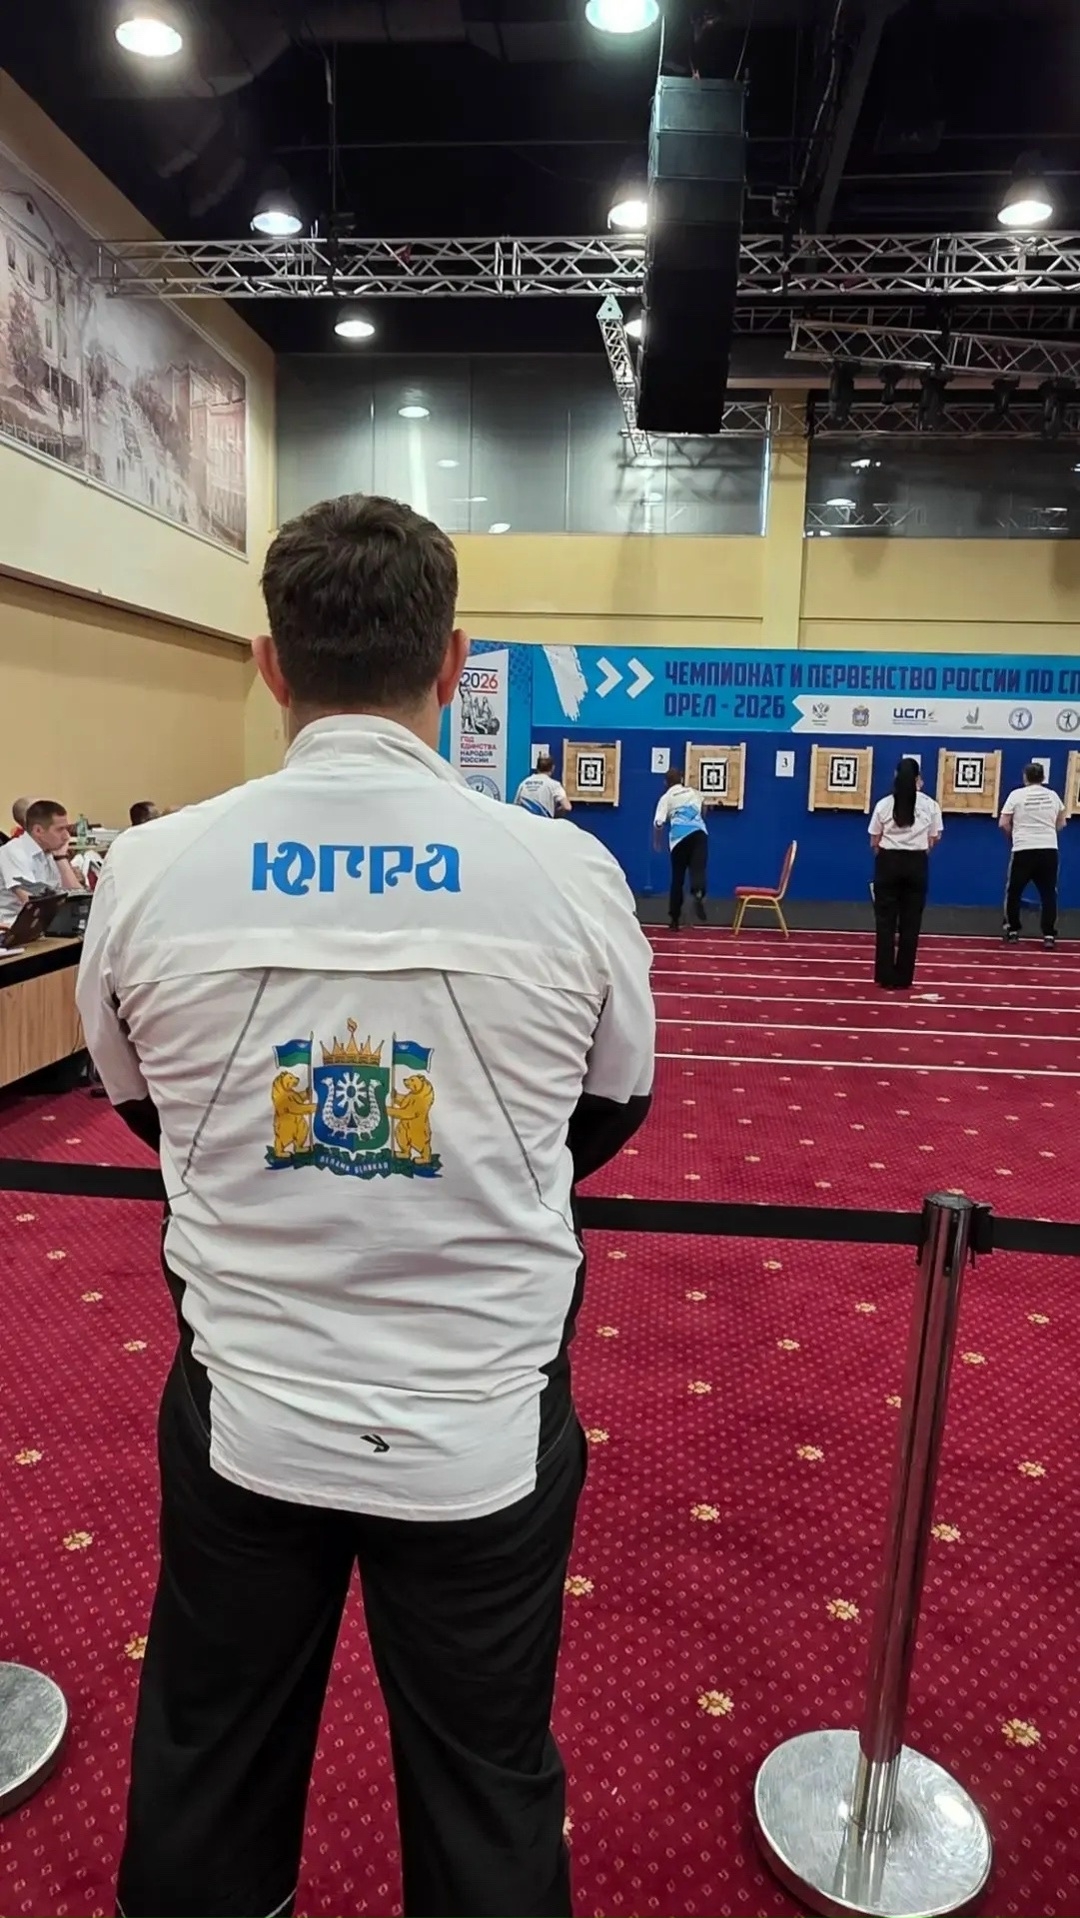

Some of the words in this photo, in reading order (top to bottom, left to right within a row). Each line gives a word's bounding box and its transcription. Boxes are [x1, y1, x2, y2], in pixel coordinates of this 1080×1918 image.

[461, 671, 498, 689] 2026
[665, 661, 786, 687] ЧЕМПИОНАТ
[790, 663, 803, 688] И
[808, 664, 937, 690] ПЕРВЕНСТВО
[942, 667, 1020, 693] РОССИИ
[1025, 669, 1054, 694] ПО
[664, 692, 716, 717] ОРЕЛ
[734, 694, 785, 719] 2026
[657, 754, 664, 765] 2
[782, 758, 789, 768] 3
